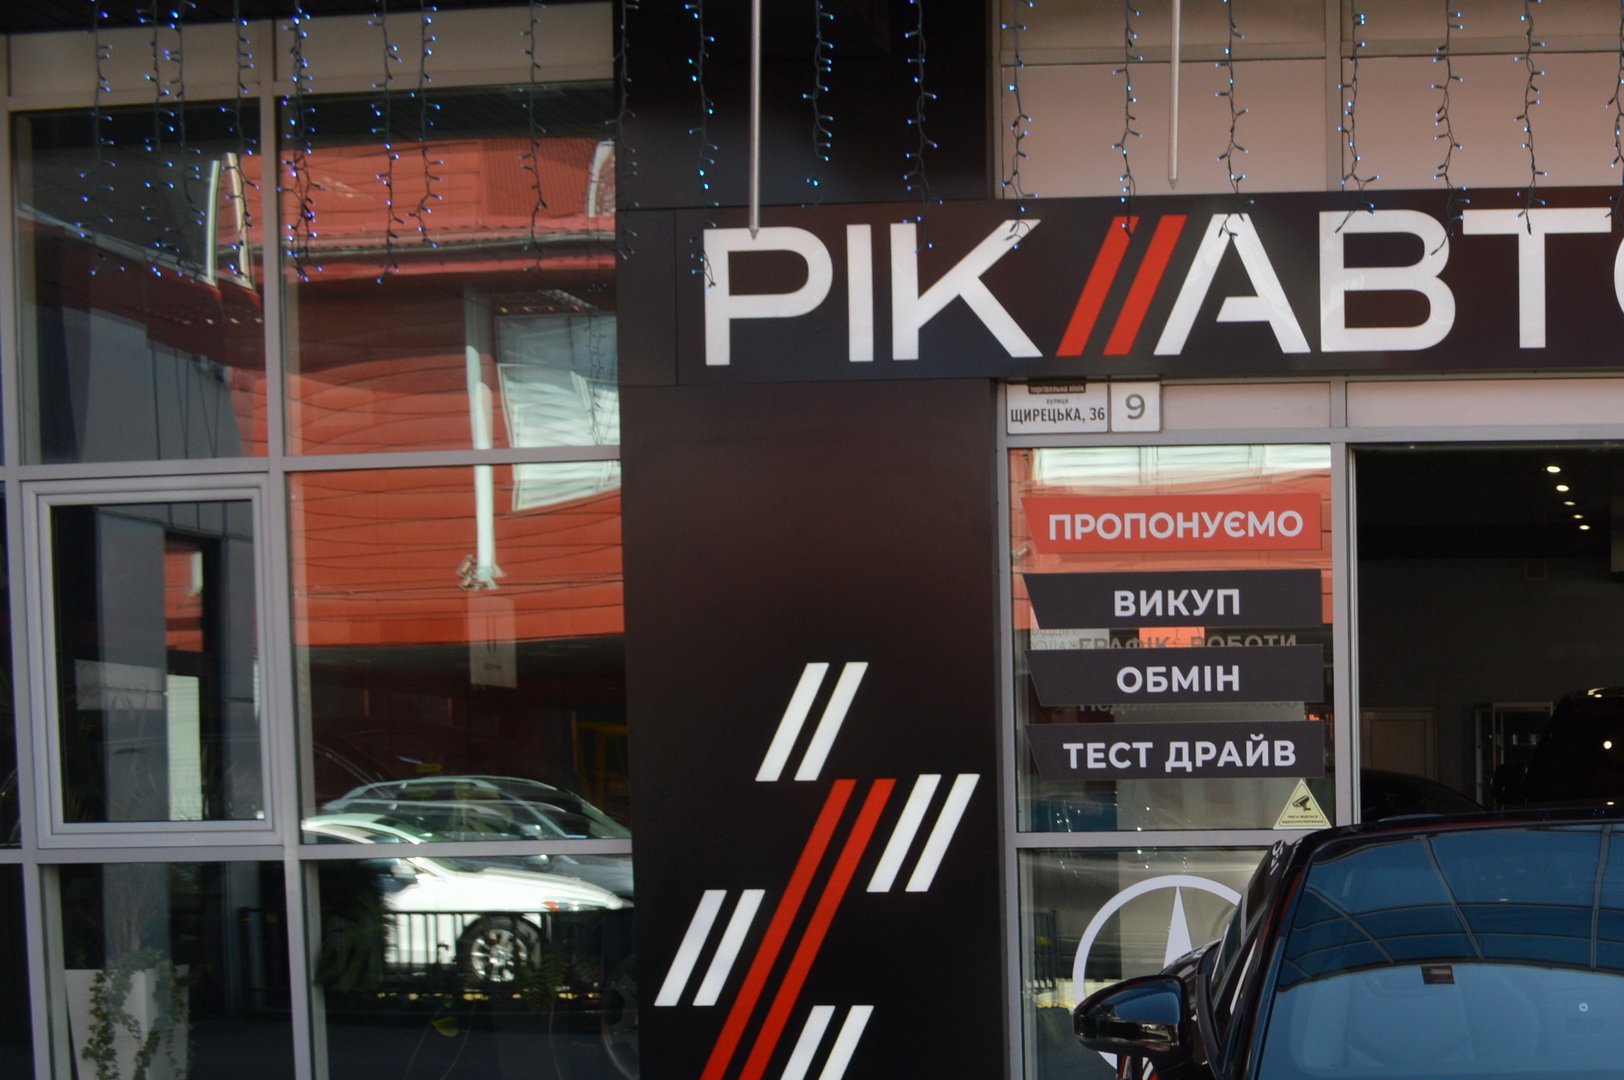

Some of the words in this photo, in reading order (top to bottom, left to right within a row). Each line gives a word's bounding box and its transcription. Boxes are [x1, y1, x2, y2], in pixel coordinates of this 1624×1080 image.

[1010, 407, 1086, 425] ЩИРЕЦЬКА,
[1089, 407, 1105, 422] 36
[1125, 393, 1146, 420] 9
[1049, 510, 1304, 541] ПРОПОНУЄМО
[1113, 588, 1241, 618] ВИКУП
[1116, 664, 1241, 694] ОБМІН
[1063, 742, 1153, 770] ТЕСТ
[1165, 733, 1297, 773] ДРАЙВ
